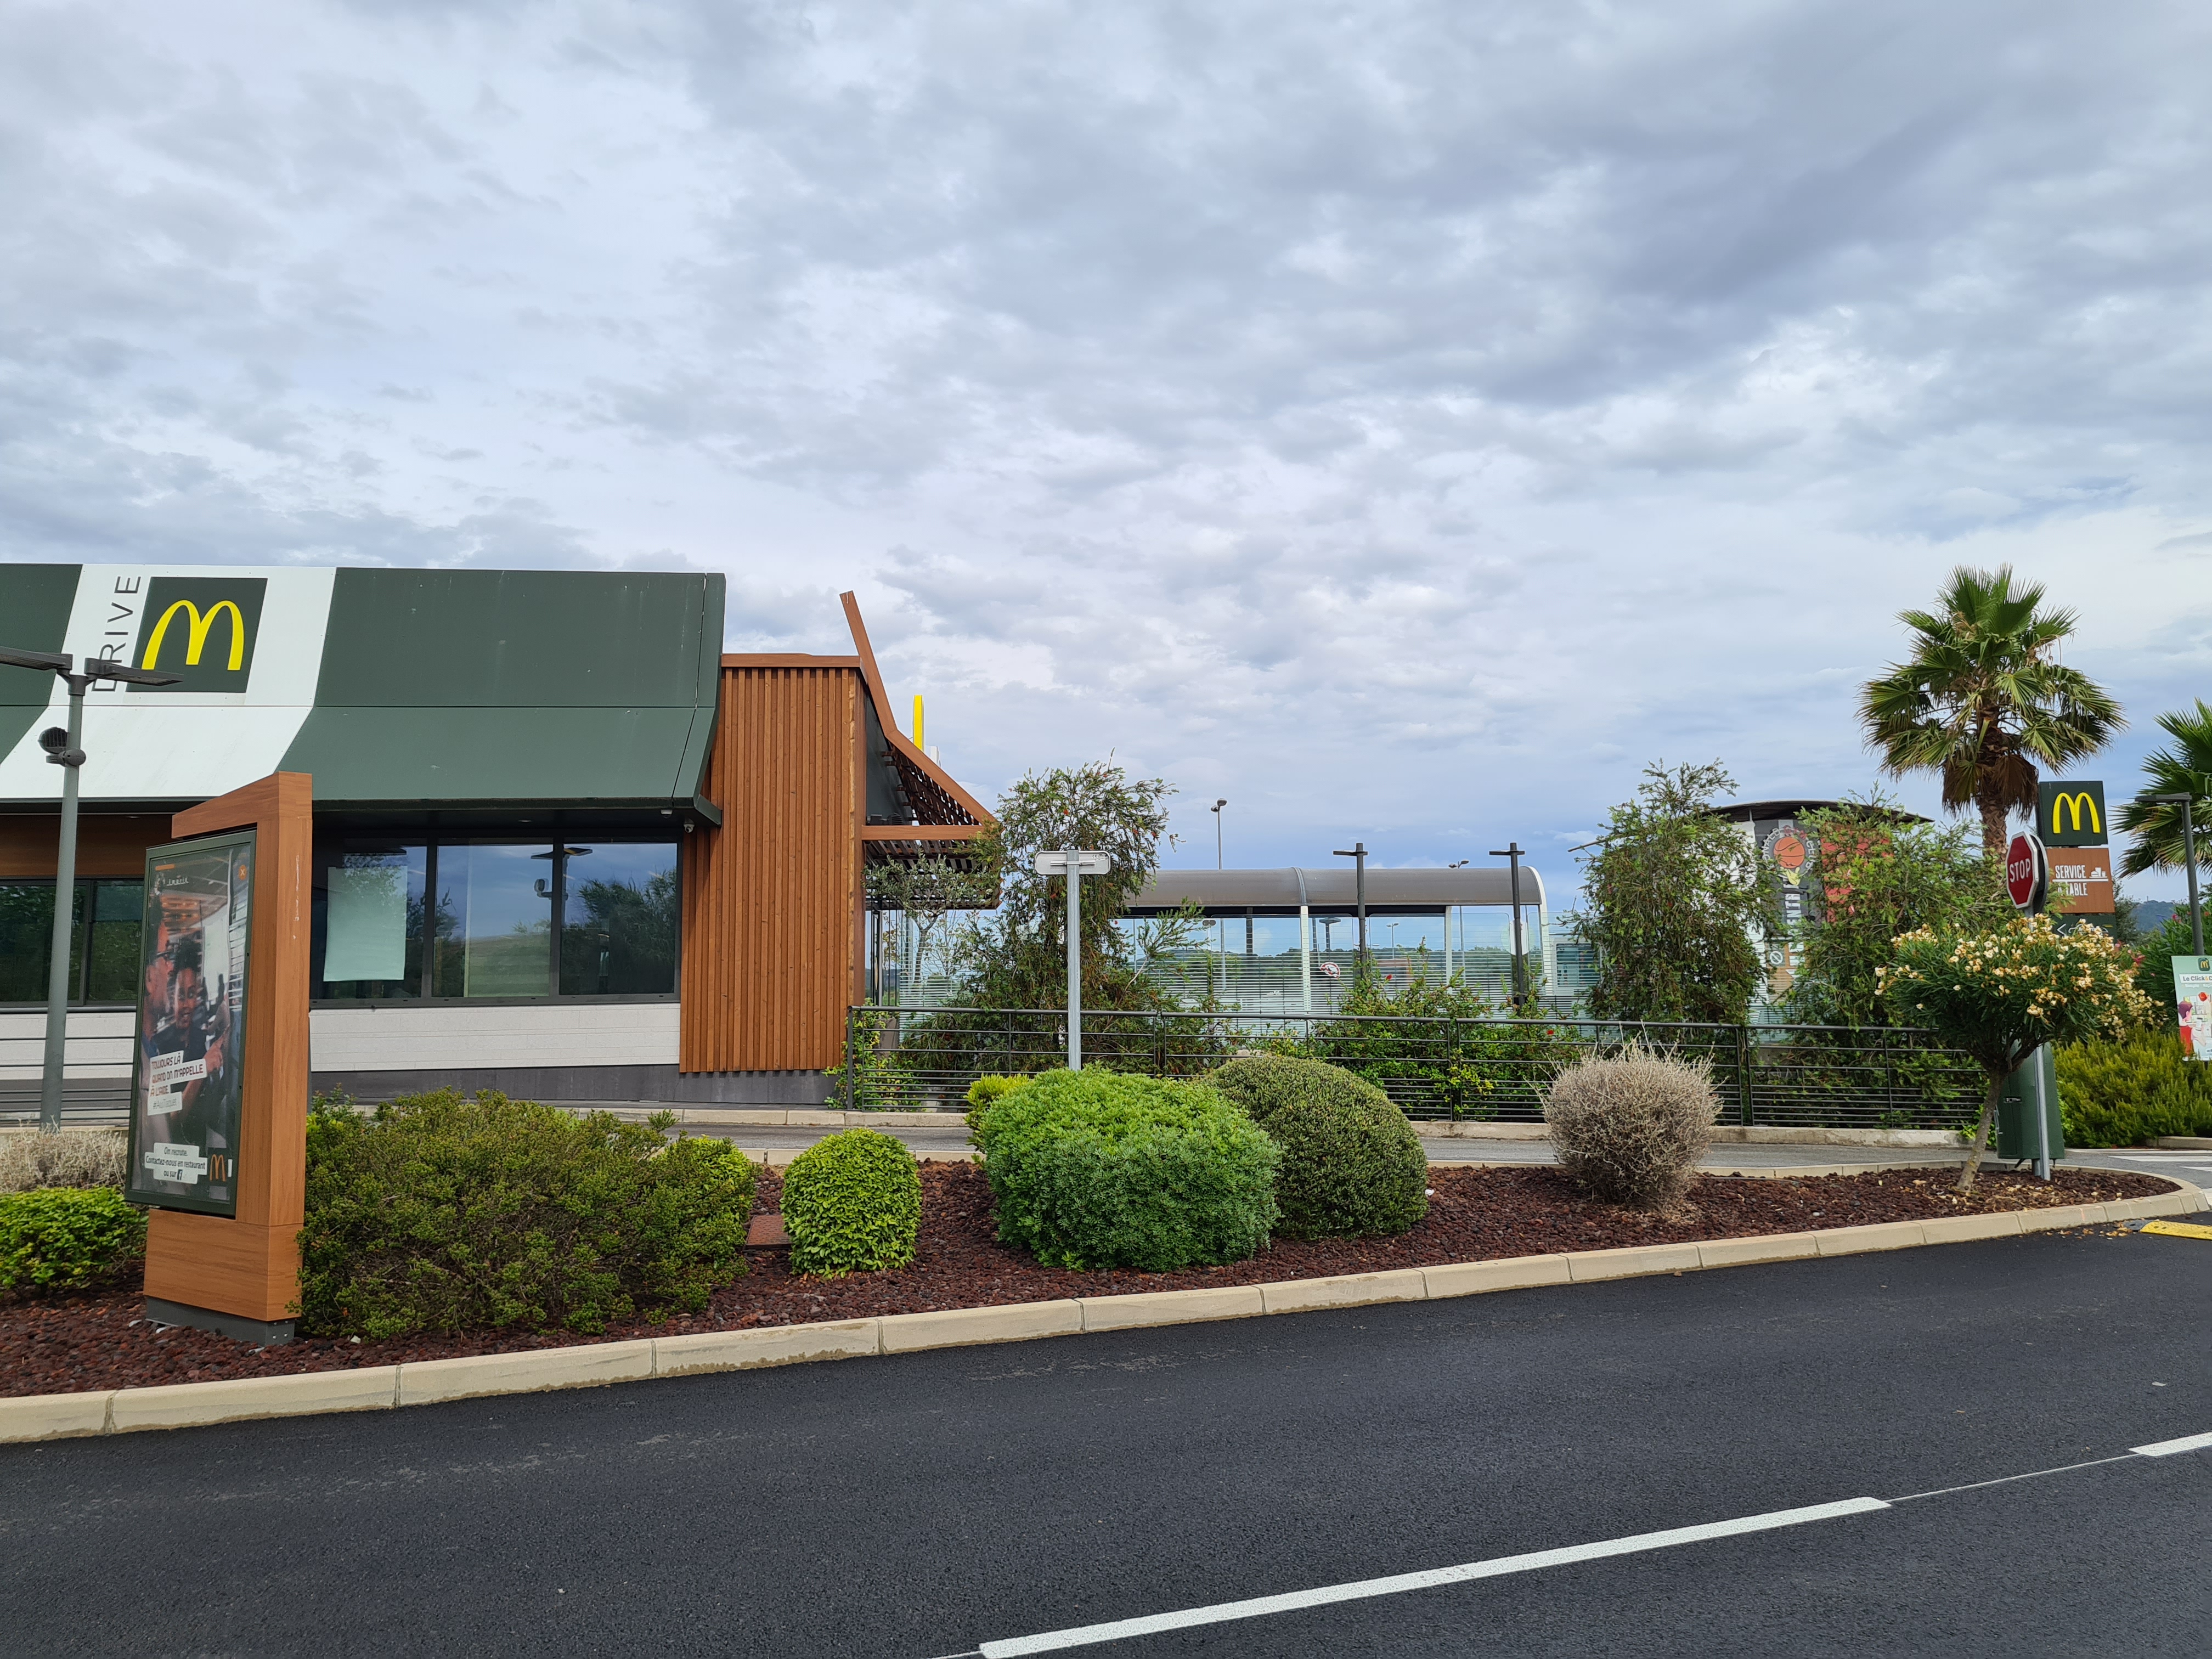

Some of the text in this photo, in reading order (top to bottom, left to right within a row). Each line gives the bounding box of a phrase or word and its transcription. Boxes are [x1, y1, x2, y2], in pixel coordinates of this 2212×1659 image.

[91, 576, 141, 692] DRIVE
[2009, 858, 2031, 883] STOP
[2055, 865, 2086, 879] SERVICE
[184, 1161, 205, 1170] restaurant
